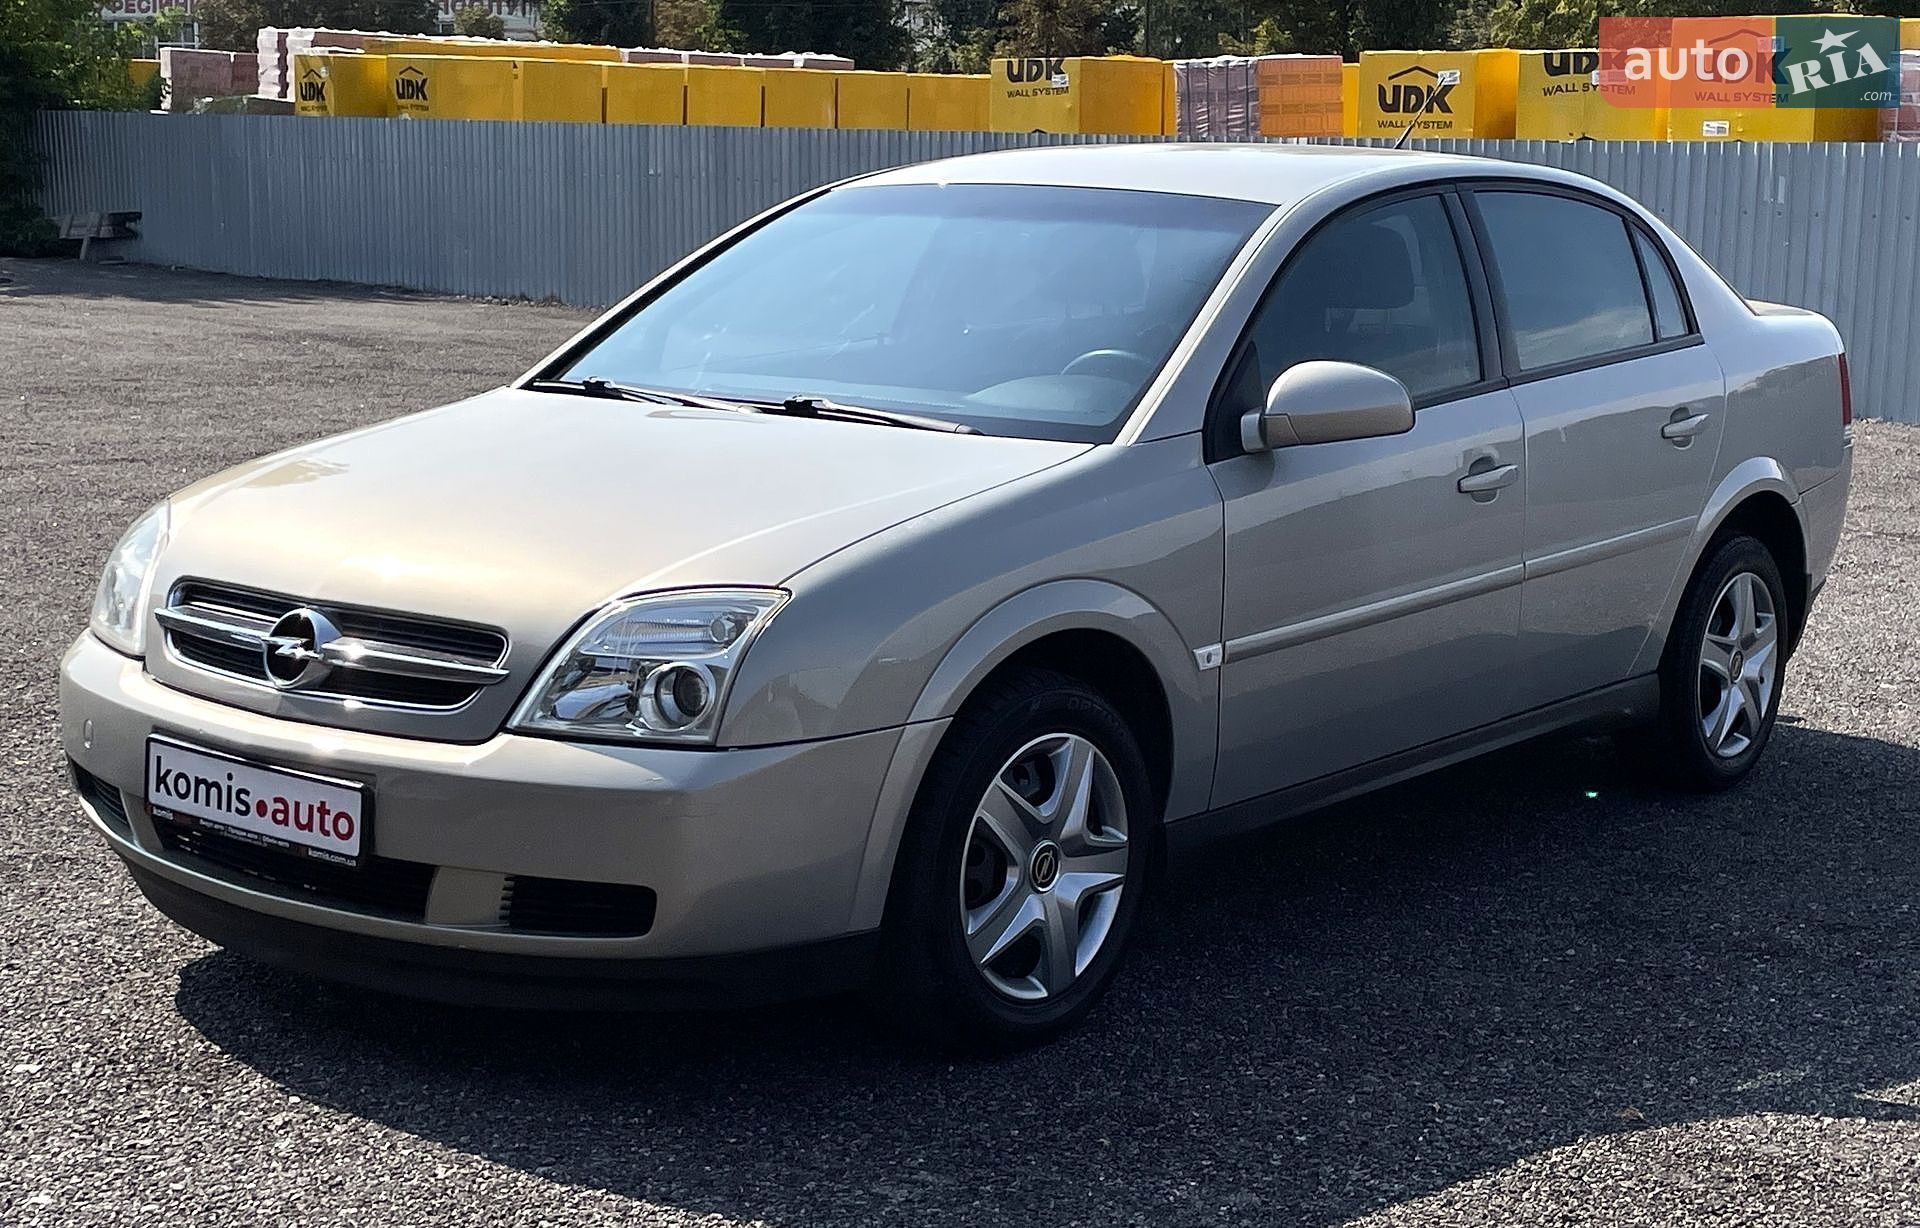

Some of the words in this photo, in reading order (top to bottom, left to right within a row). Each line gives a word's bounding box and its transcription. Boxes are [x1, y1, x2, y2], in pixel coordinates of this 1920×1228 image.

[1006, 58, 1066, 83] UDK
[299, 81, 326, 102] UDK
[395, 78, 428, 101] UDK
[1007, 88, 1030, 98] WALL
[1032, 86, 1069, 97] SYSTEM
[1378, 83, 1456, 113] UDK
[1543, 83, 1579, 96] WALL
[1582, 83, 1636, 95] SYSTEM
[1694, 91, 1730, 102] WALL
[1733, 92, 1789, 103] SYSTEM
[1377, 120, 1406, 129] WALL
[1408, 120, 1453, 129] SYSTEM
